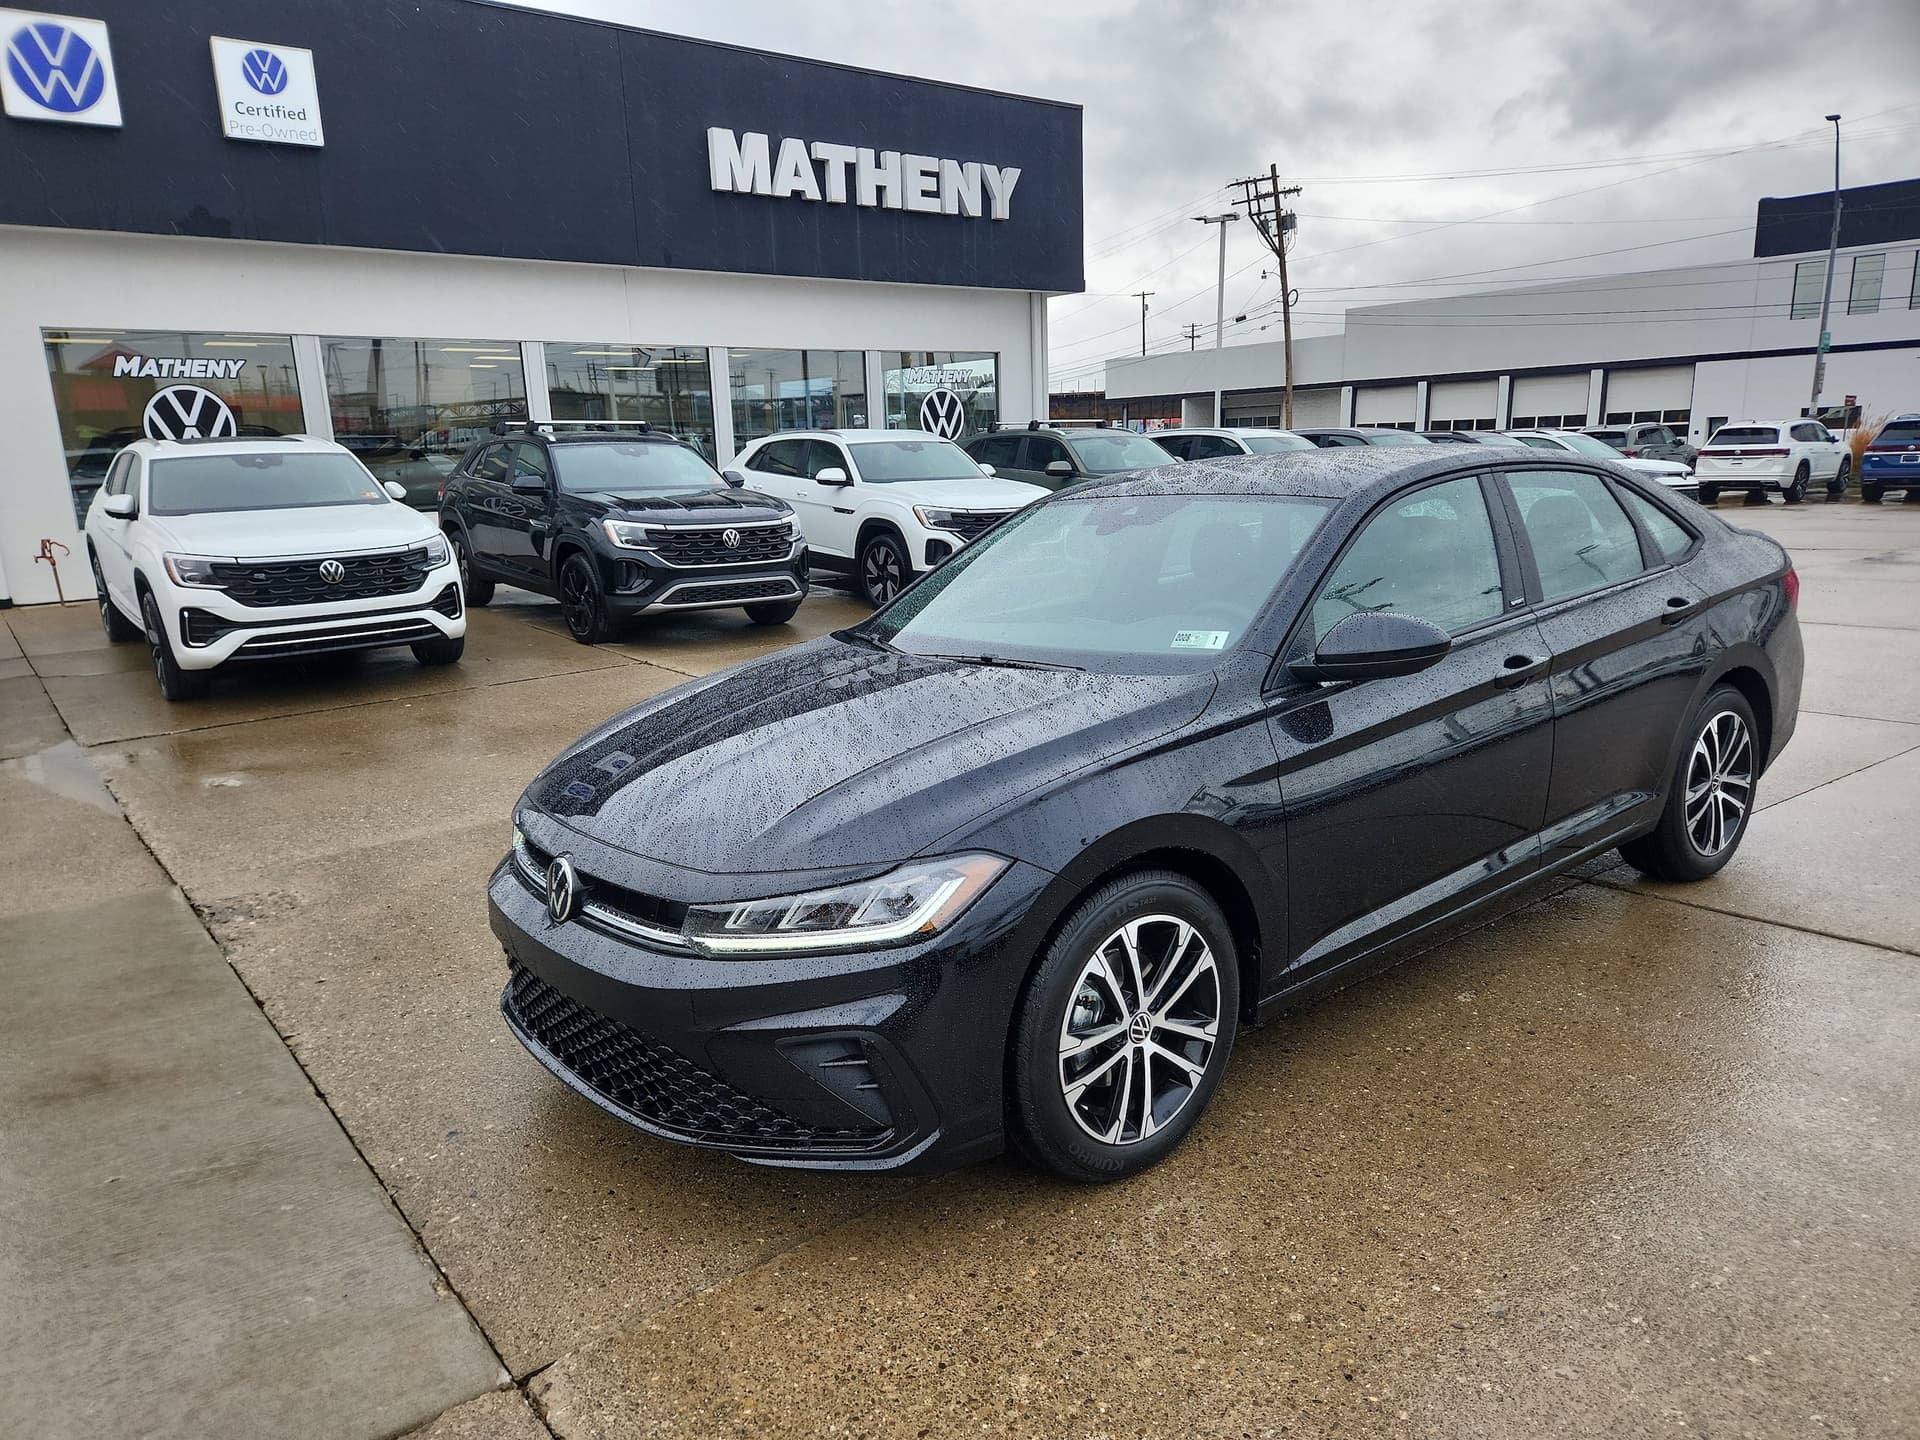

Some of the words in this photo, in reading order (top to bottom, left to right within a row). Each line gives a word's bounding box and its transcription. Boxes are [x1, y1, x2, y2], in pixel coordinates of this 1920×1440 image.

[235, 101, 307, 121] Certified
[229, 120, 318, 142] Pre-Owned
[707, 126, 1022, 221] MATHENY
[113, 355, 246, 379] MATHENY
[908, 367, 973, 385] MATHENY
